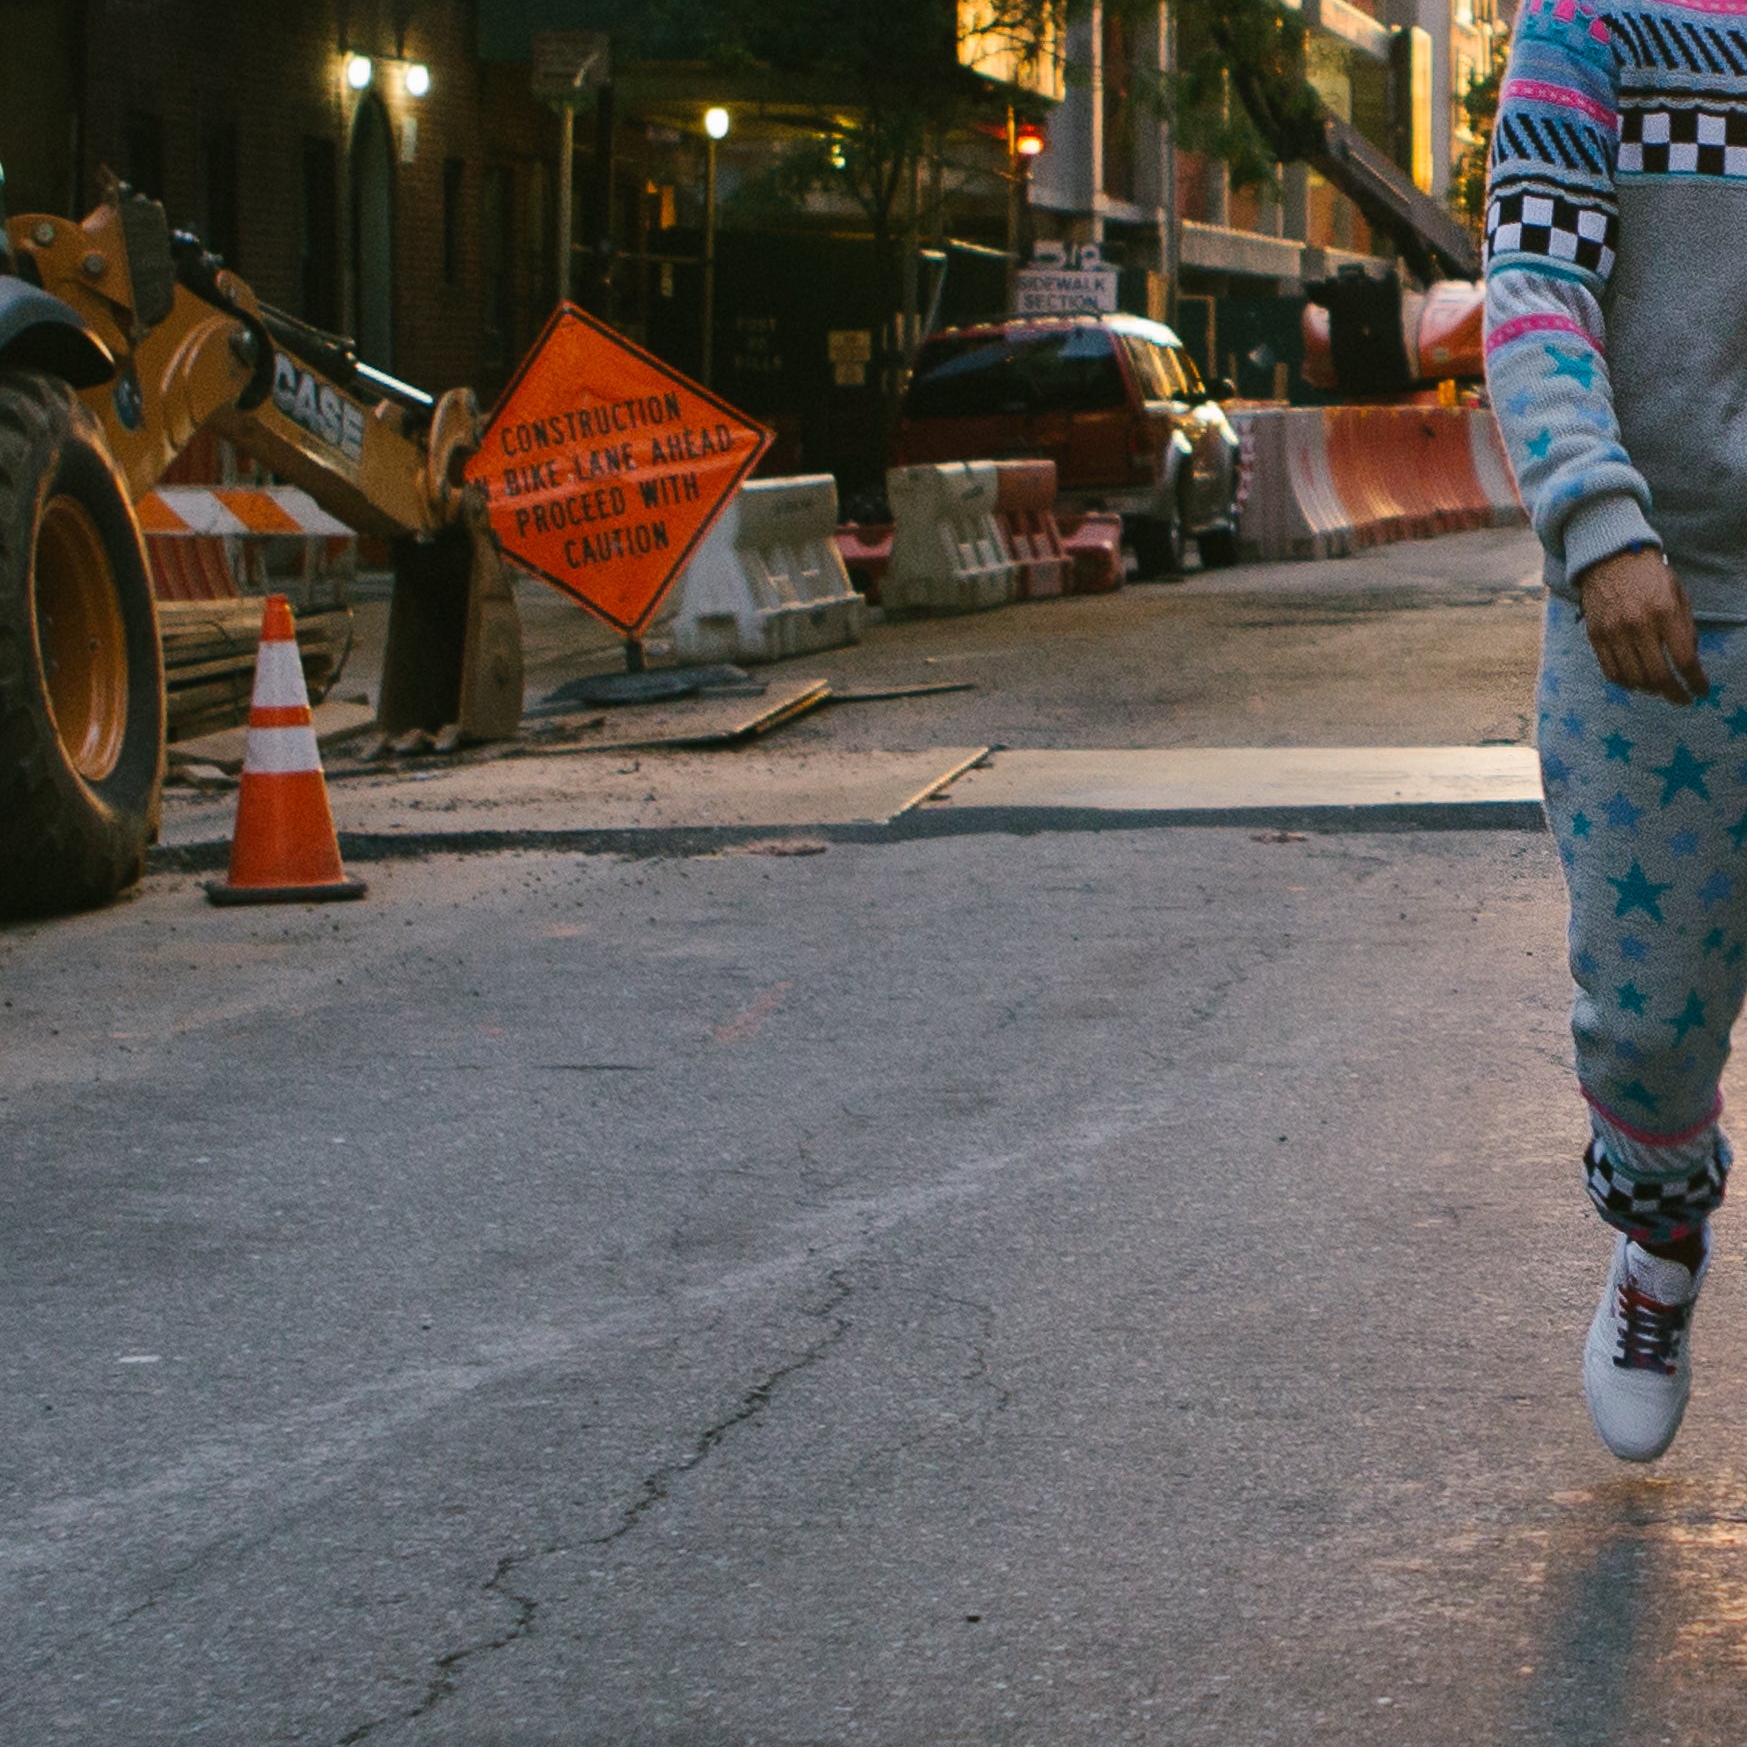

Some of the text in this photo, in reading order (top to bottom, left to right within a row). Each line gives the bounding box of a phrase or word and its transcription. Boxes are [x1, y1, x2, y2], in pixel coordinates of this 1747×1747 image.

[272, 352, 365, 463] CASE
[501, 391, 682, 457] CONSTRUCTION
[503, 459, 560, 496] BIKE
[574, 442, 637, 481] LANE
[651, 424, 734, 465] AHEAD
[515, 471, 700, 538] PROCEED WITH
[563, 520, 671, 569] CAUTION
